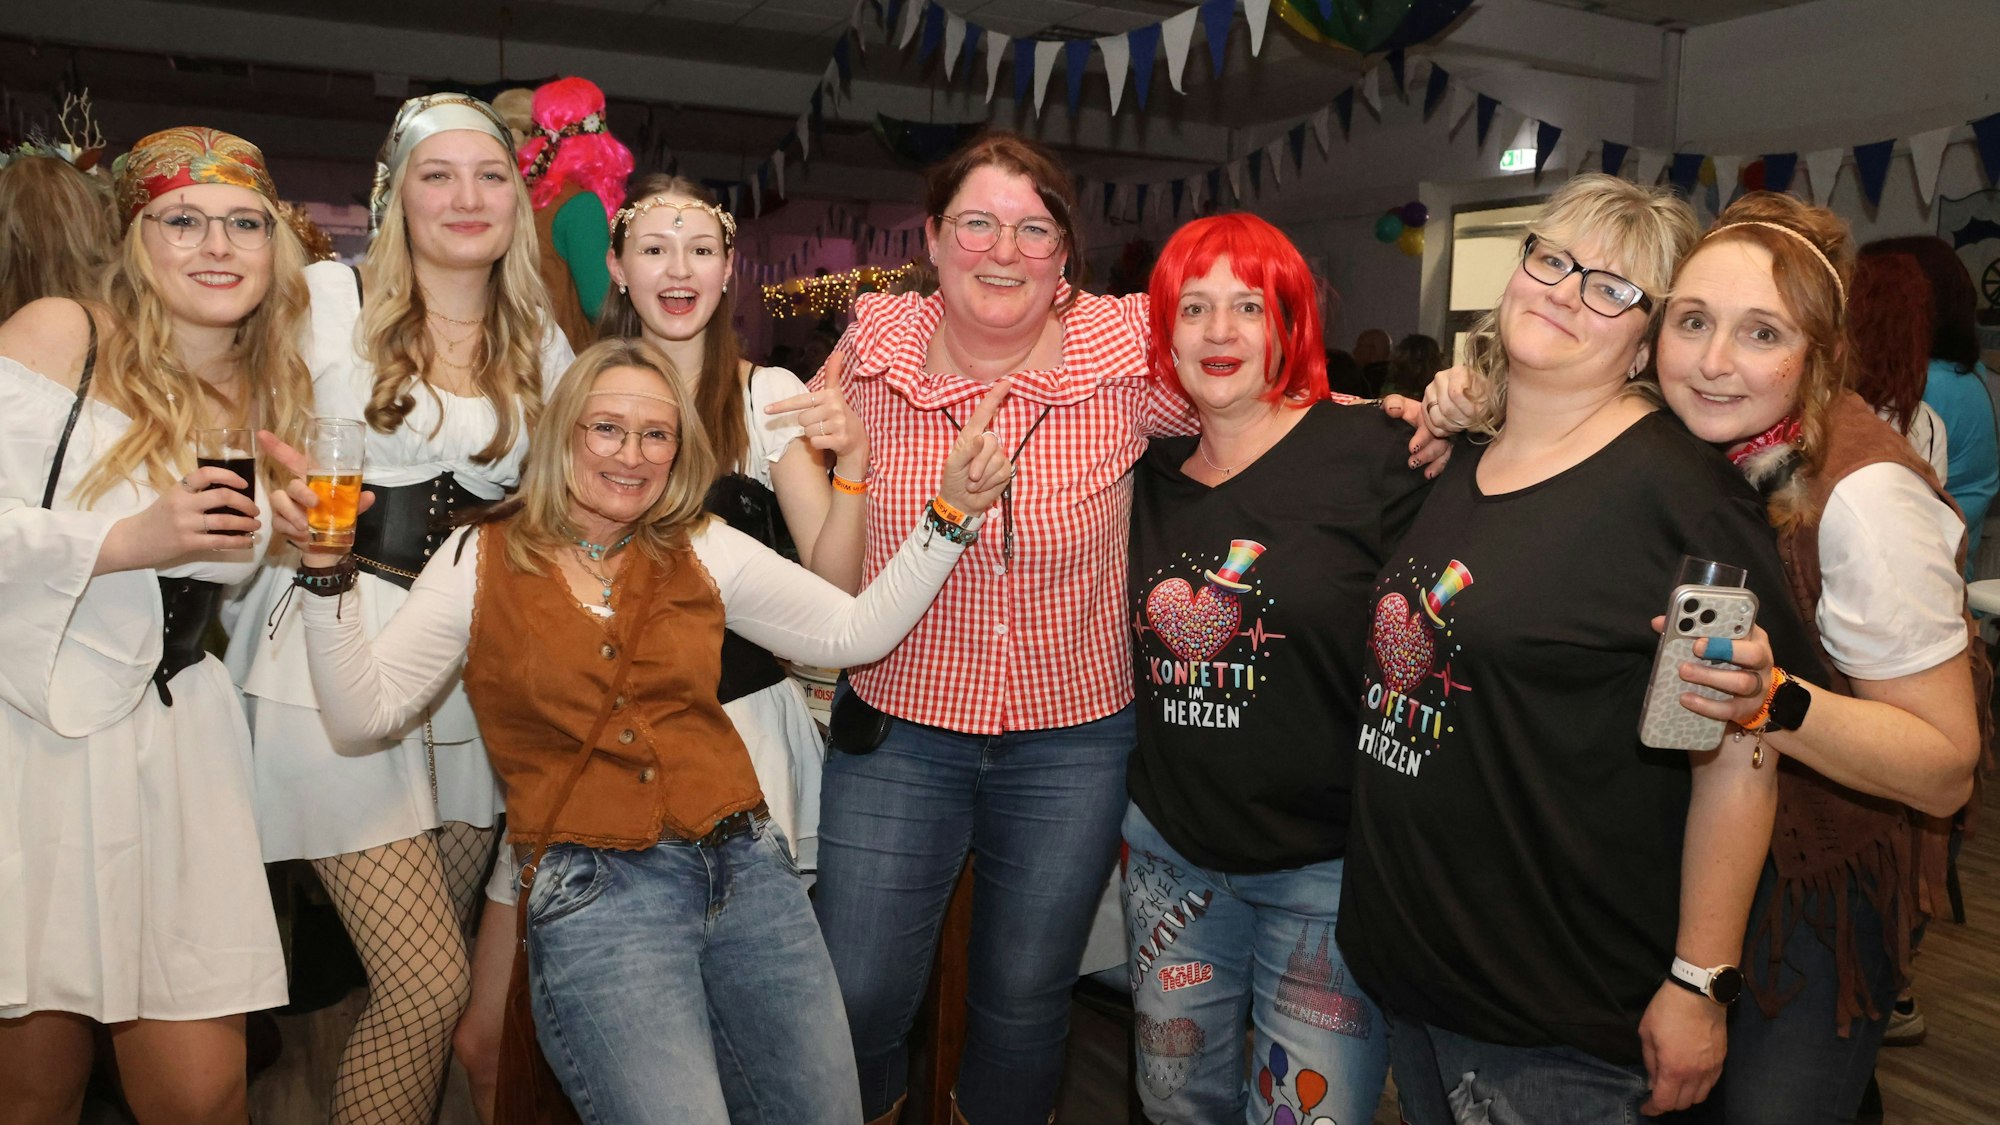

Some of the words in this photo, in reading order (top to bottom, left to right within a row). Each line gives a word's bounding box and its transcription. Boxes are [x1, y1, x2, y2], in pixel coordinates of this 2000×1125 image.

[1150, 656, 1254, 691] KONFETTI
[1188, 686, 1204, 700] IM
[1163, 698, 1240, 728] HERZEN
[1381, 717, 1396, 737] IM
[1358, 724, 1422, 777] HERZEN
[1158, 961, 1213, 992] Kölle
